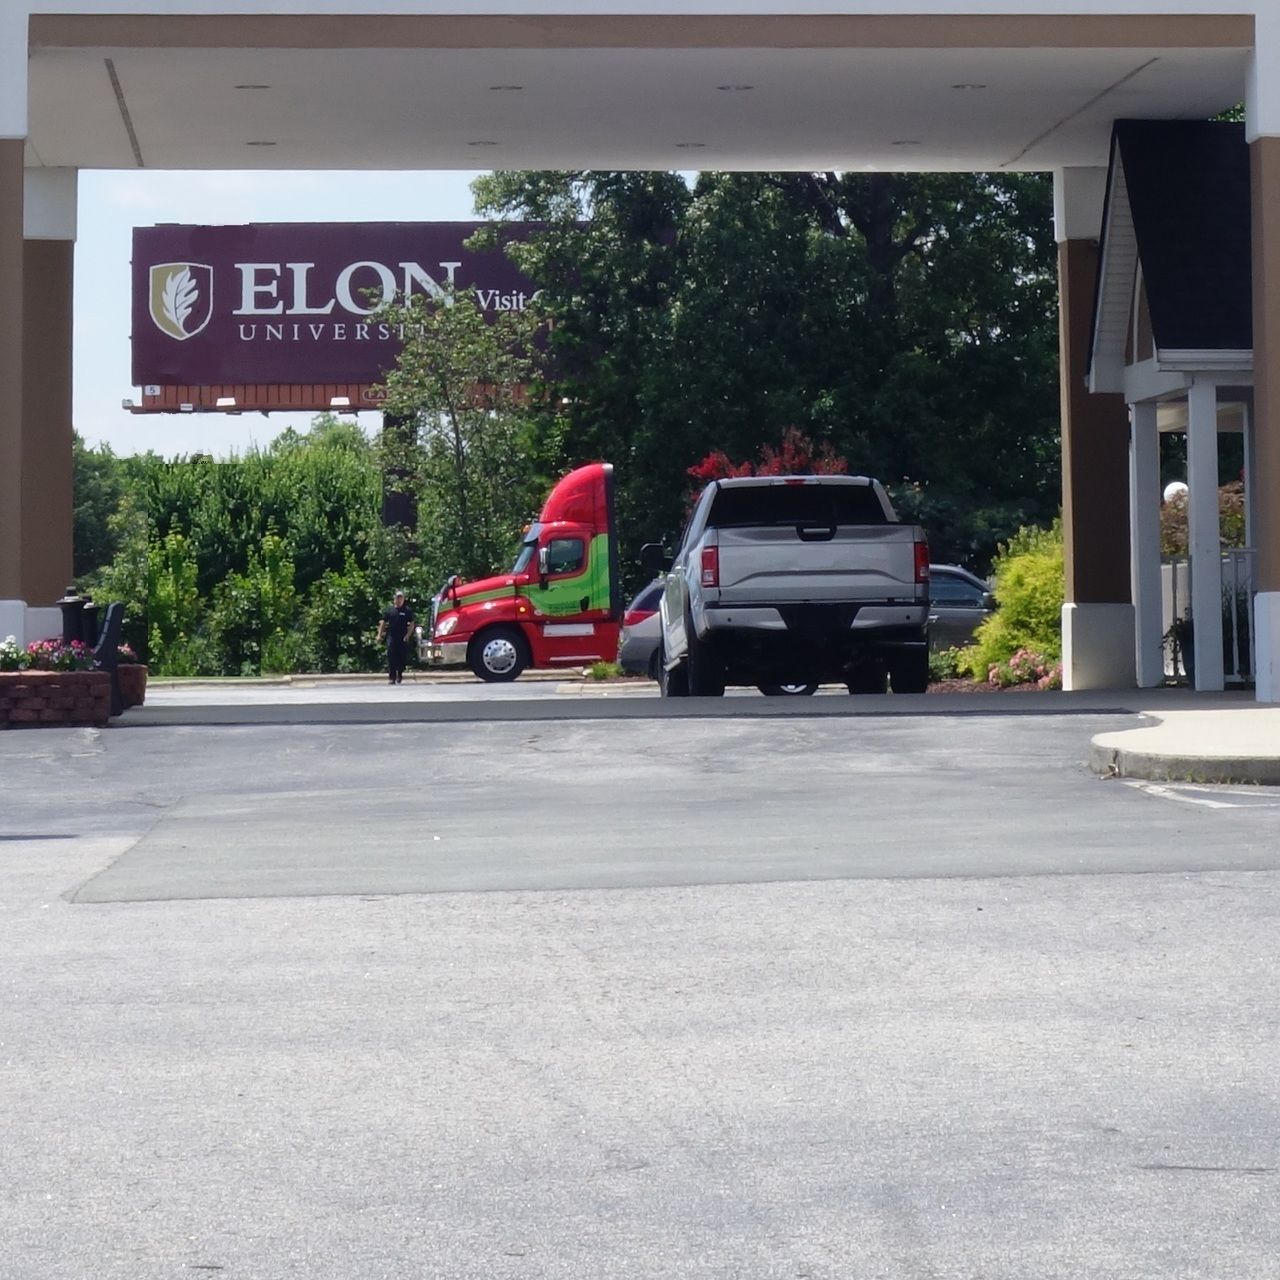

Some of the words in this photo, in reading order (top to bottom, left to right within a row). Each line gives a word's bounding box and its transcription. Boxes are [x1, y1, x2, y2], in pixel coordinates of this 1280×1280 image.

[232, 261, 462, 315] ELON
[475, 289, 527, 311] Visit
[239, 323, 425, 341] UNIVERSI
